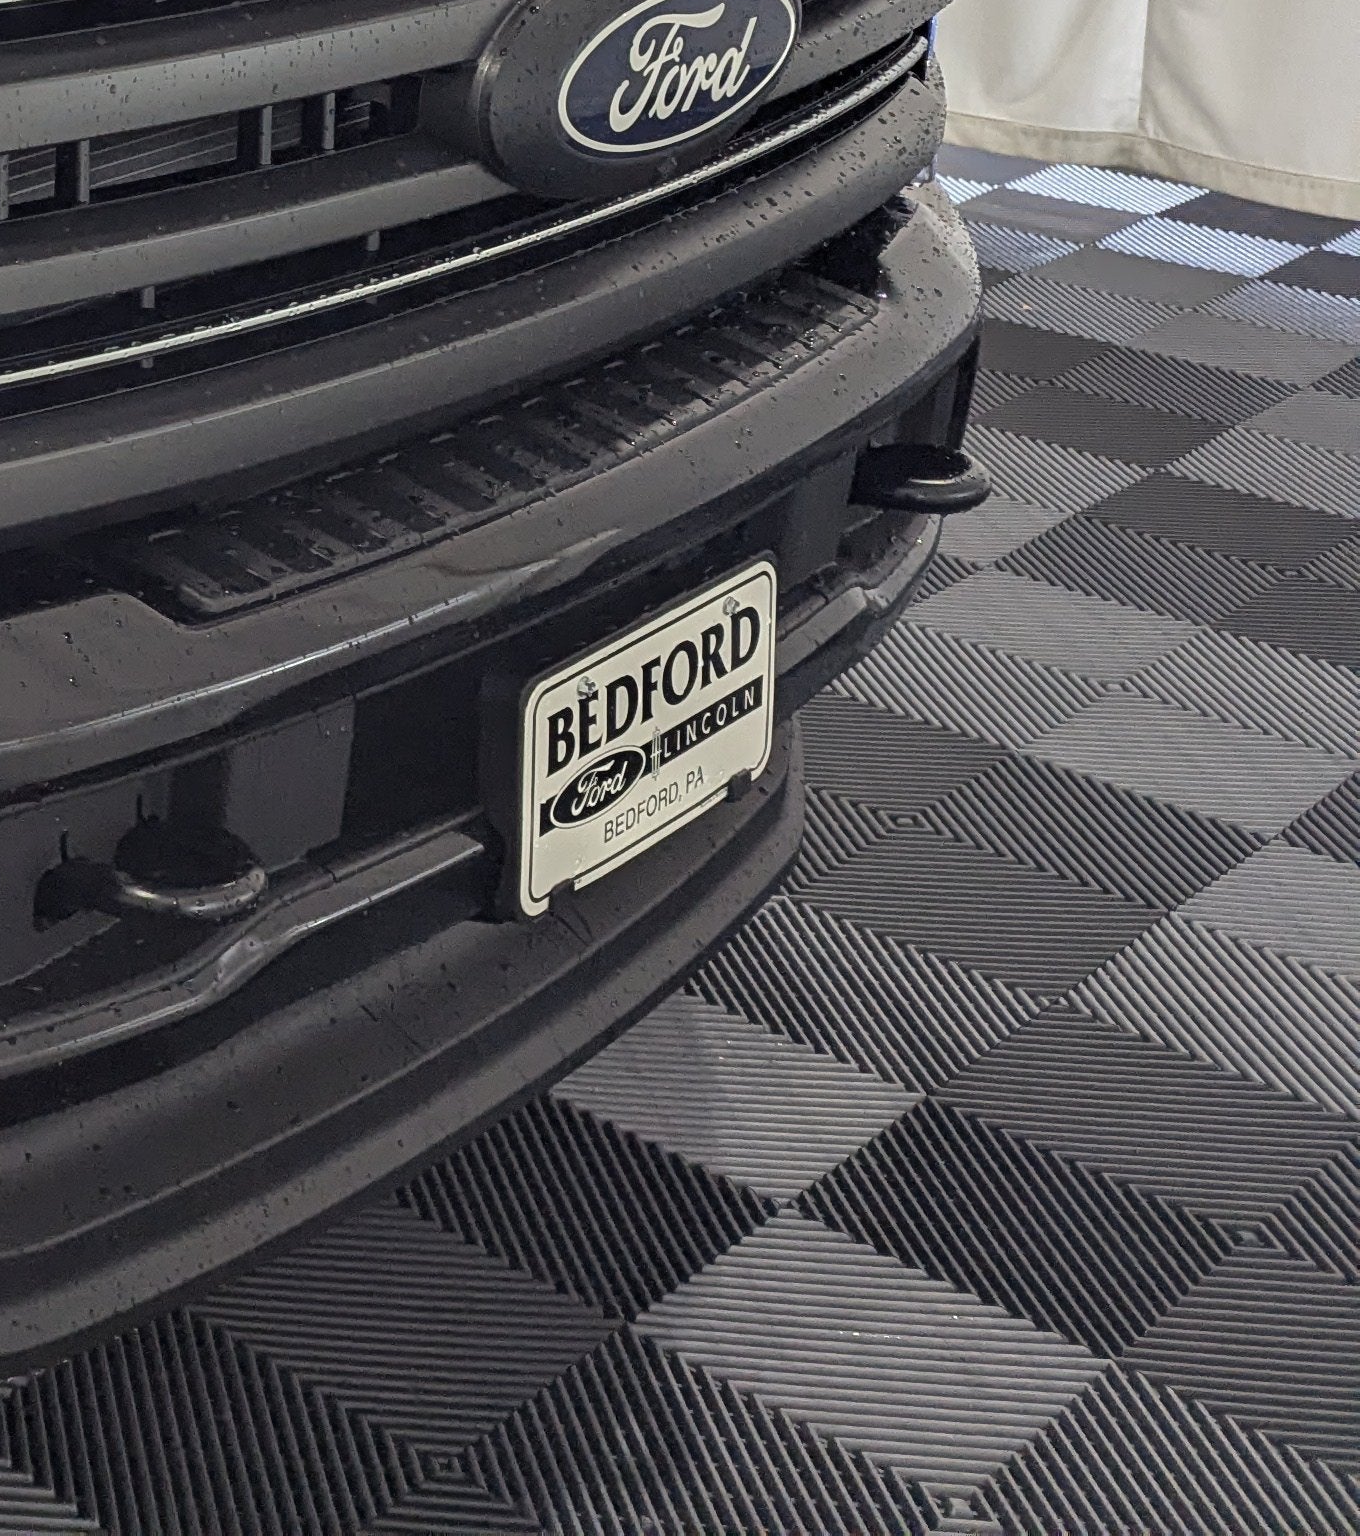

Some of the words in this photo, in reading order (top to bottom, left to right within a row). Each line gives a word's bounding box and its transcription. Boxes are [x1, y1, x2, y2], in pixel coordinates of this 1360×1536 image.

[609, 2, 757, 132] Ford
[546, 606, 761, 778] BEDFORD
[571, 759, 628, 816] Ford
[664, 685, 755, 758] LINCOLN
[604, 782, 683, 844] BEDFORD,
[686, 765, 705, 796] PA
